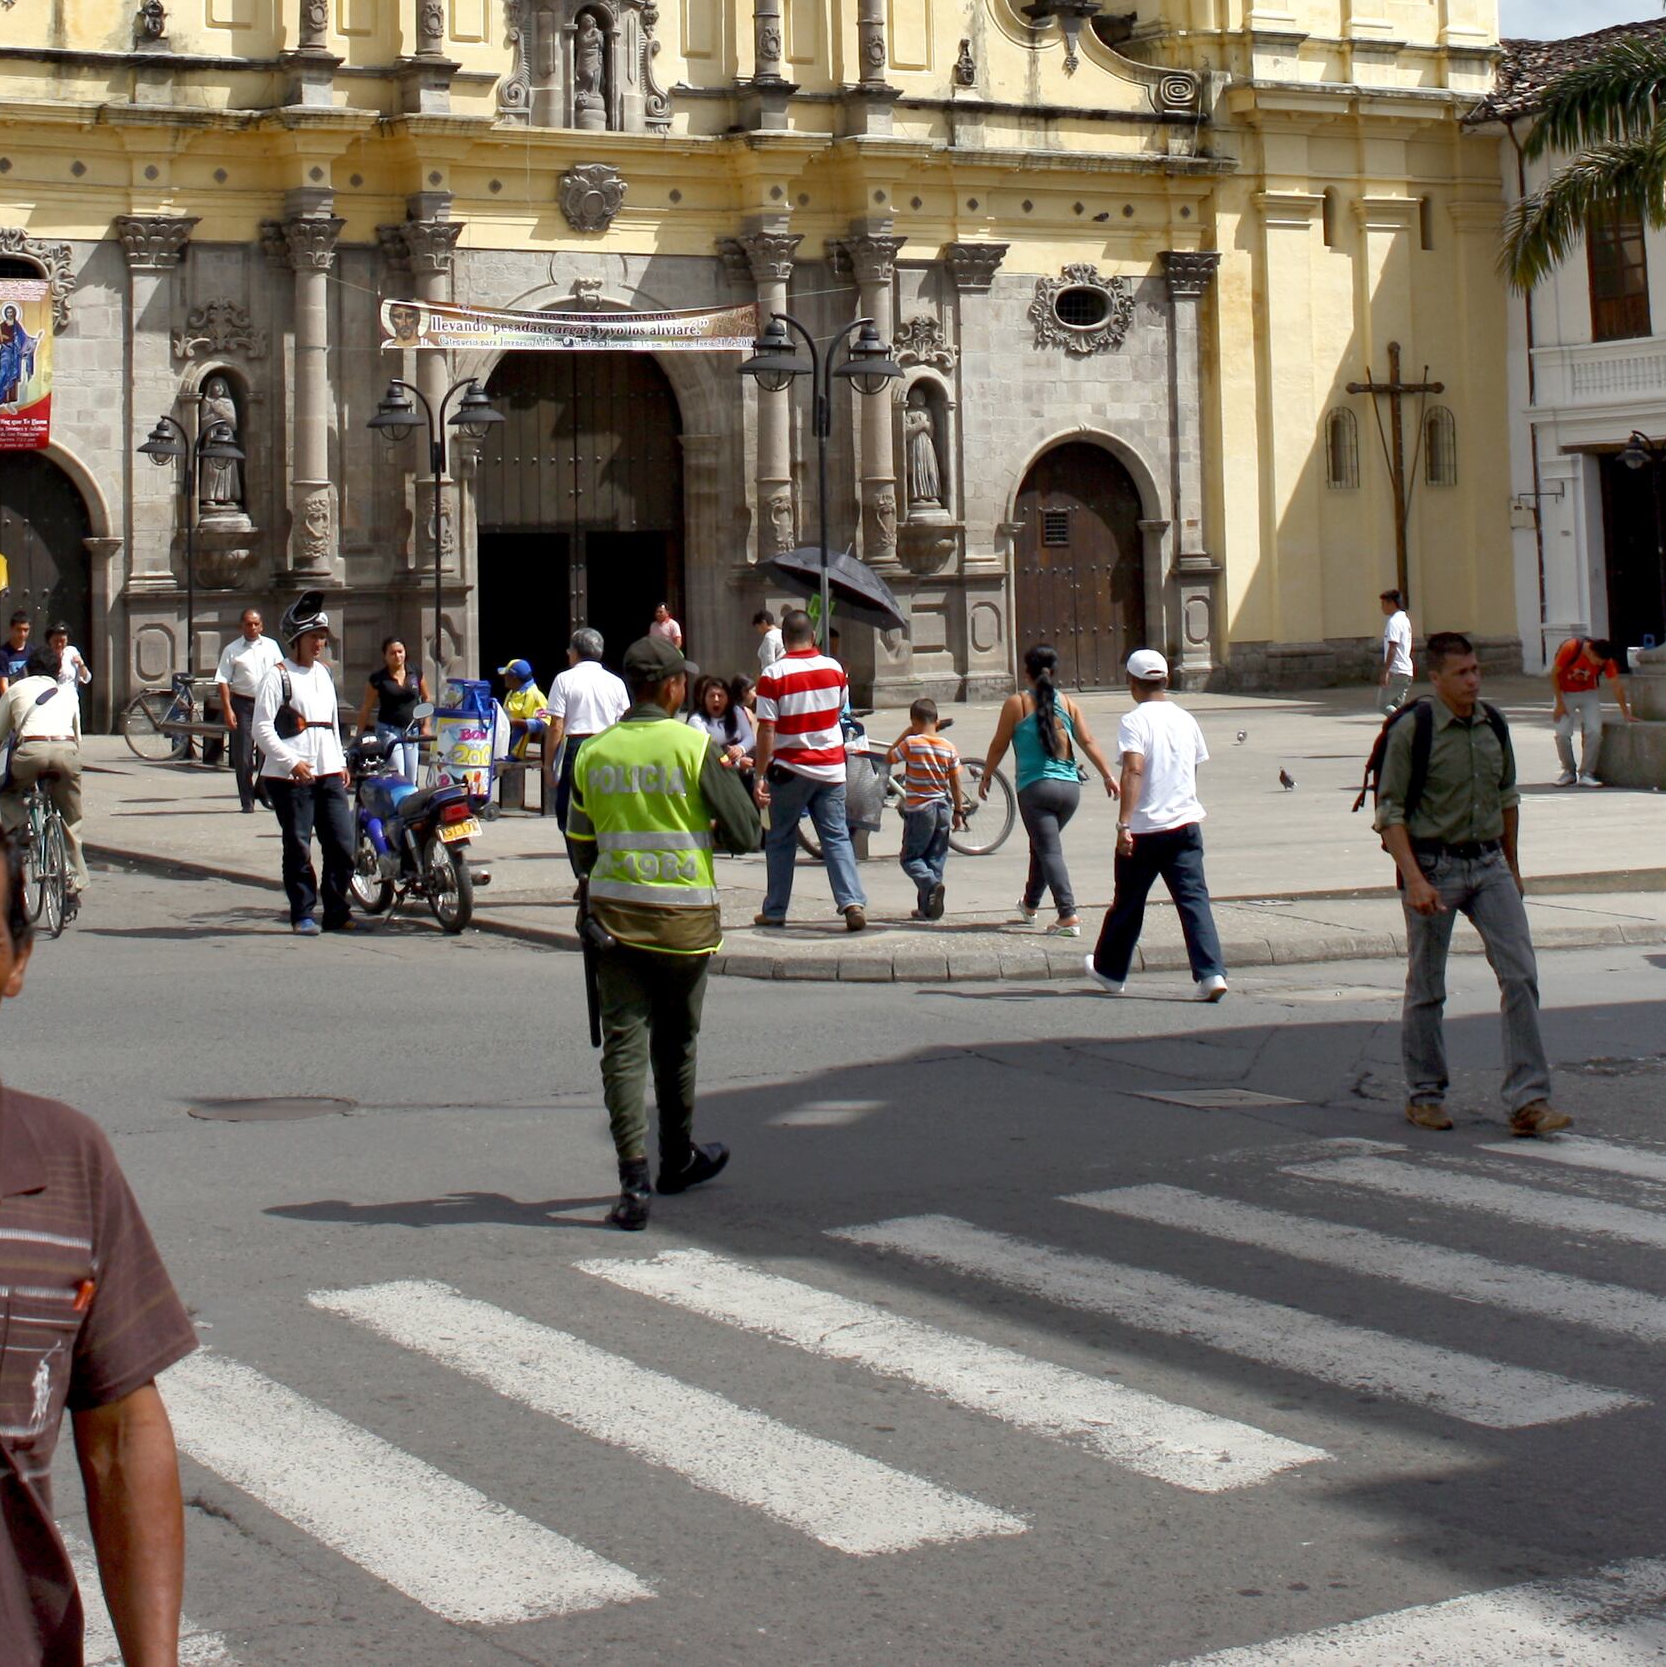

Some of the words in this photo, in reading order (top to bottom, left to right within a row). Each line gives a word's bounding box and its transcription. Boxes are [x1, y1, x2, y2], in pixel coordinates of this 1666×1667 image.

[431, 315, 488, 332] llevando
[493, 319, 543, 336] pesadas
[610, 327, 625, 337] yo
[628, 323, 645, 335] los
[588, 764, 686, 795] POLICIA
